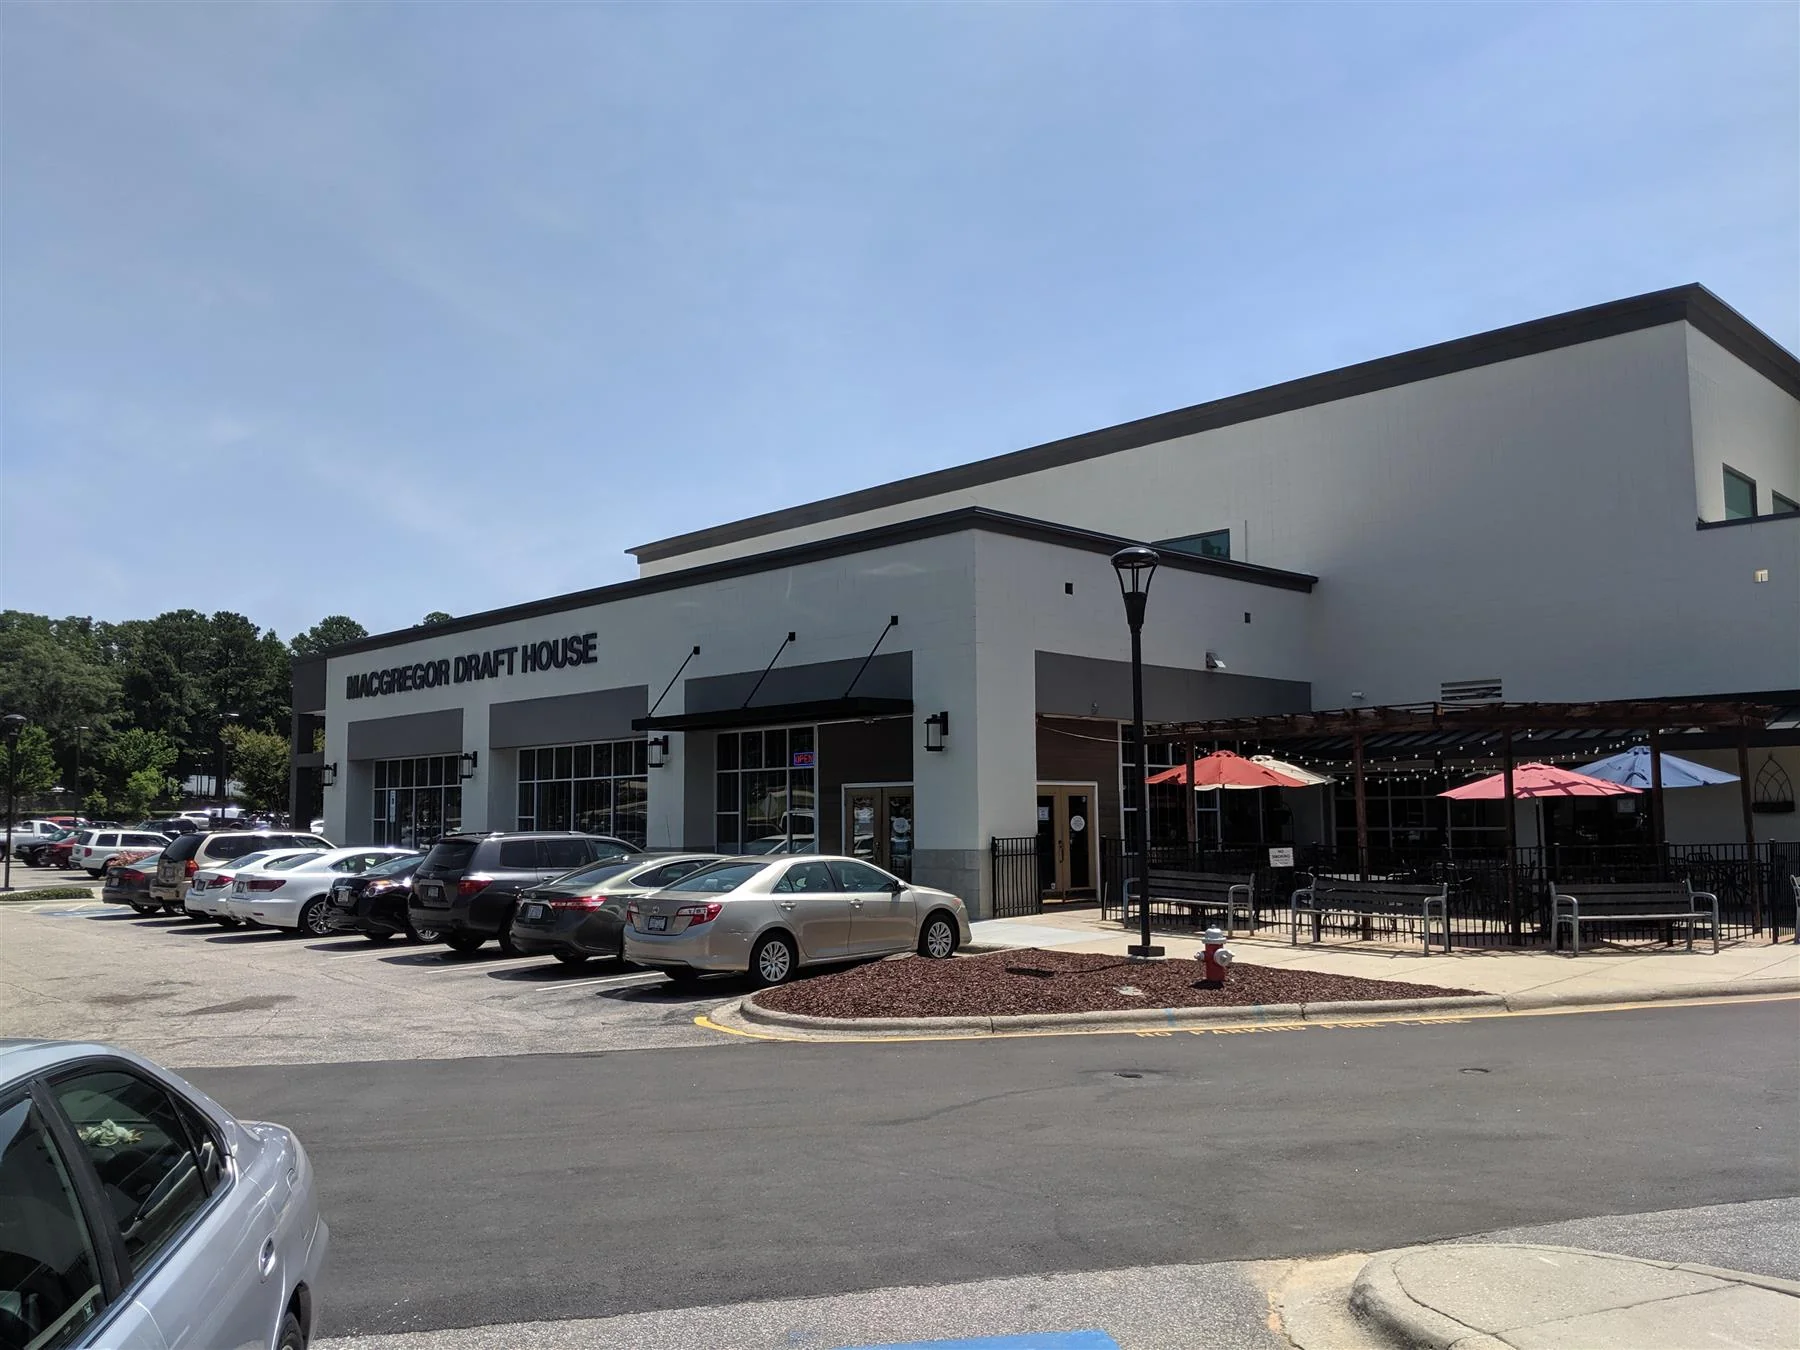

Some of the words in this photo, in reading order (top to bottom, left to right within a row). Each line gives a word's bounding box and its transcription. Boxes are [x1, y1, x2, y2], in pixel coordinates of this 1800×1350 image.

[346, 659, 450, 700] MACGREGOR
[453, 646, 518, 684] DRAFT
[521, 632, 598, 674] HOUSE
[795, 754, 814, 764] OPEN
